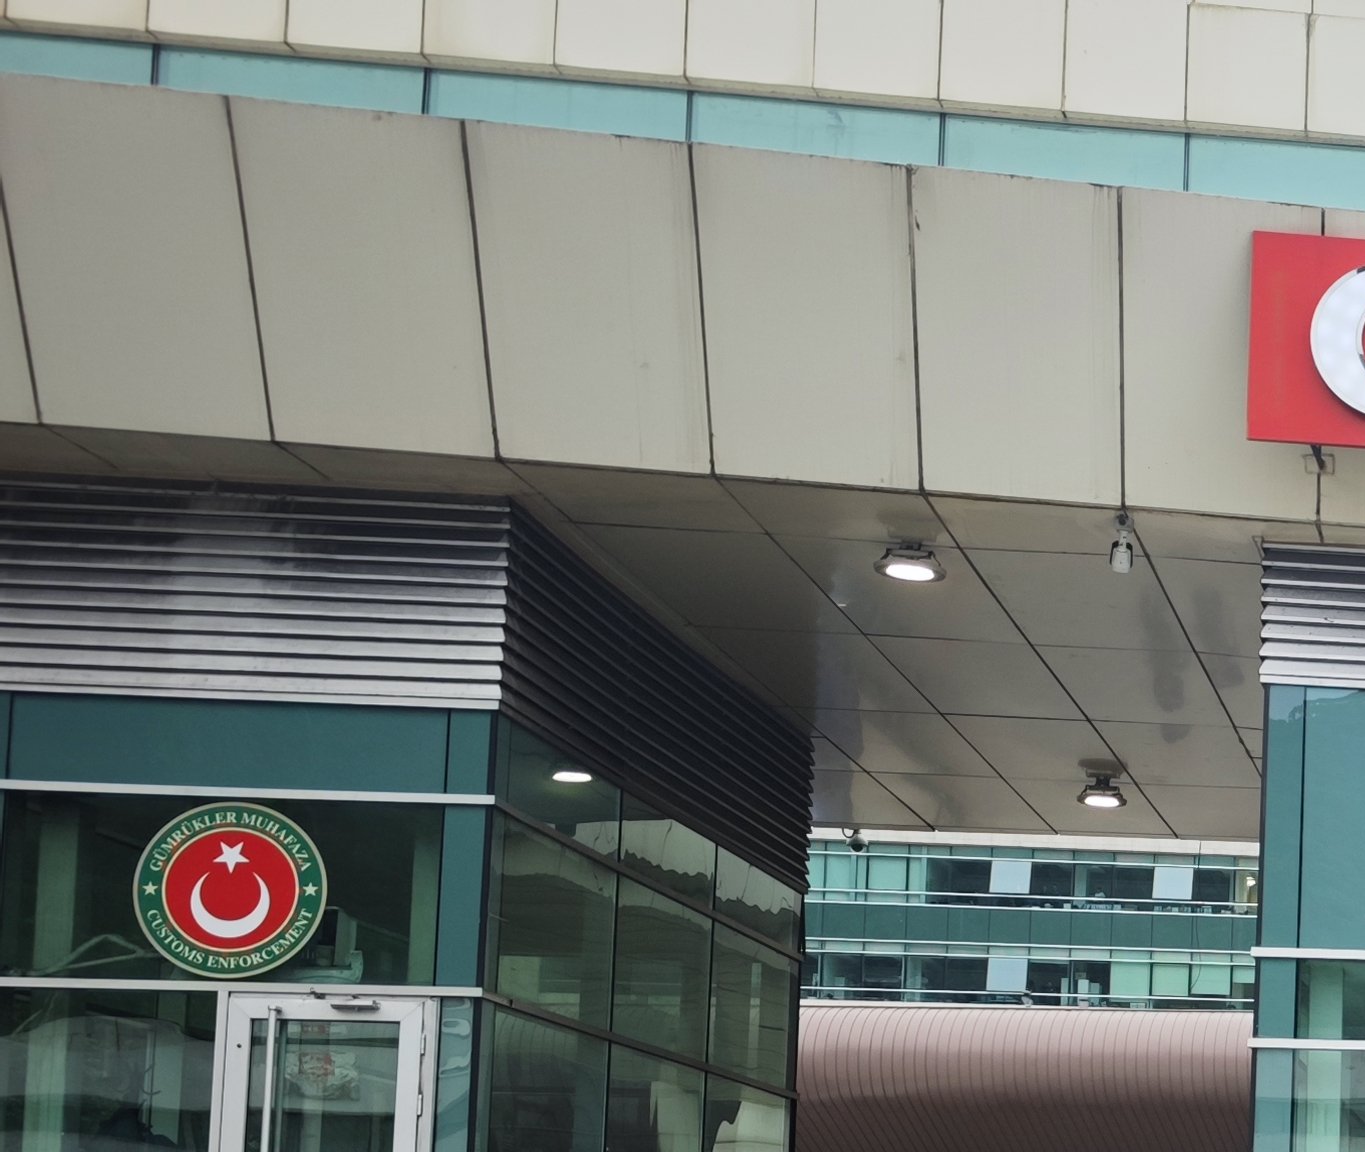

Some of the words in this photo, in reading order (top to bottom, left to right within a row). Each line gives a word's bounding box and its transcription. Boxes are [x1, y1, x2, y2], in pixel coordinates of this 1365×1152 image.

[149, 811, 238, 872] GÜMRÜKLER
[240, 812, 312, 872] MUHAFAZA
[146, 909, 205, 965] CUSTOMS
[207, 907, 313, 969] ENFORCEMENT
